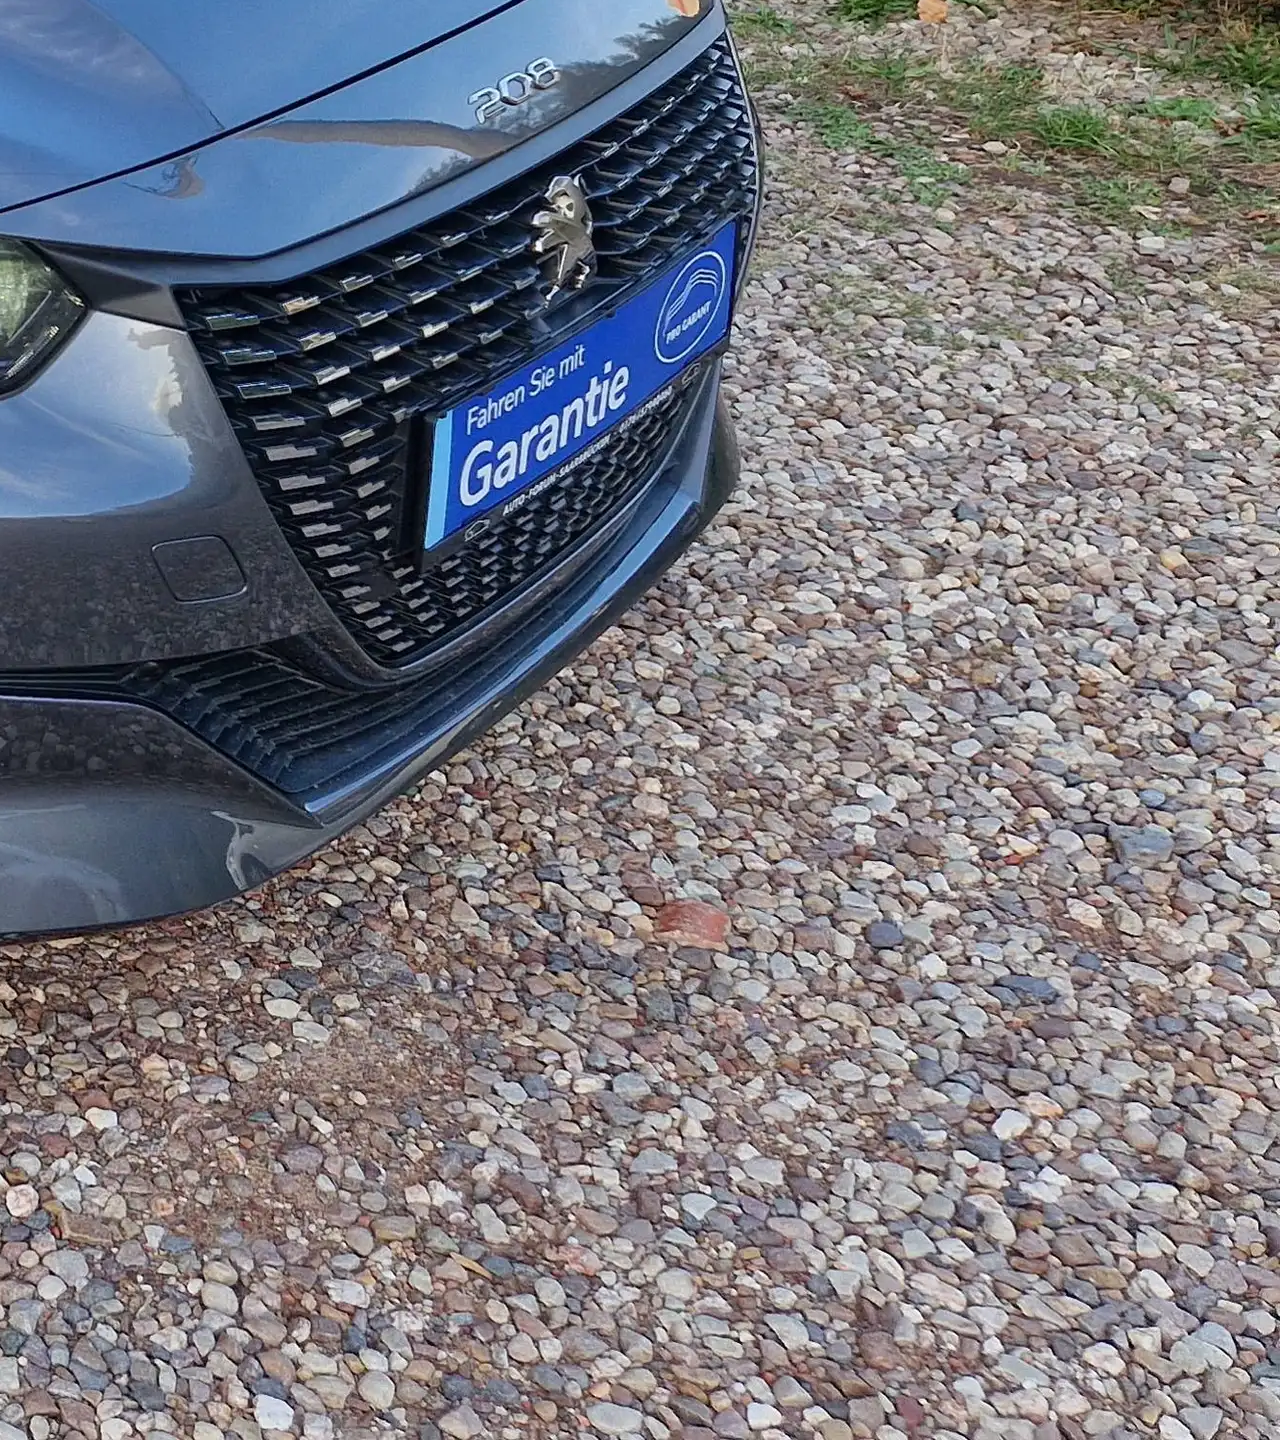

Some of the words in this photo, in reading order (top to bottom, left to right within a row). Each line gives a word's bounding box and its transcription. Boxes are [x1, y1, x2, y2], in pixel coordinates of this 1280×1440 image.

[467, 56, 561, 125] 208
[666, 324, 682, 345] PRO
[682, 300, 712, 332] GARANT
[466, 385, 525, 435] Fahren
[530, 365, 555, 397] Sie
[559, 344, 587, 379] mit
[460, 360, 629, 506] Garantie
